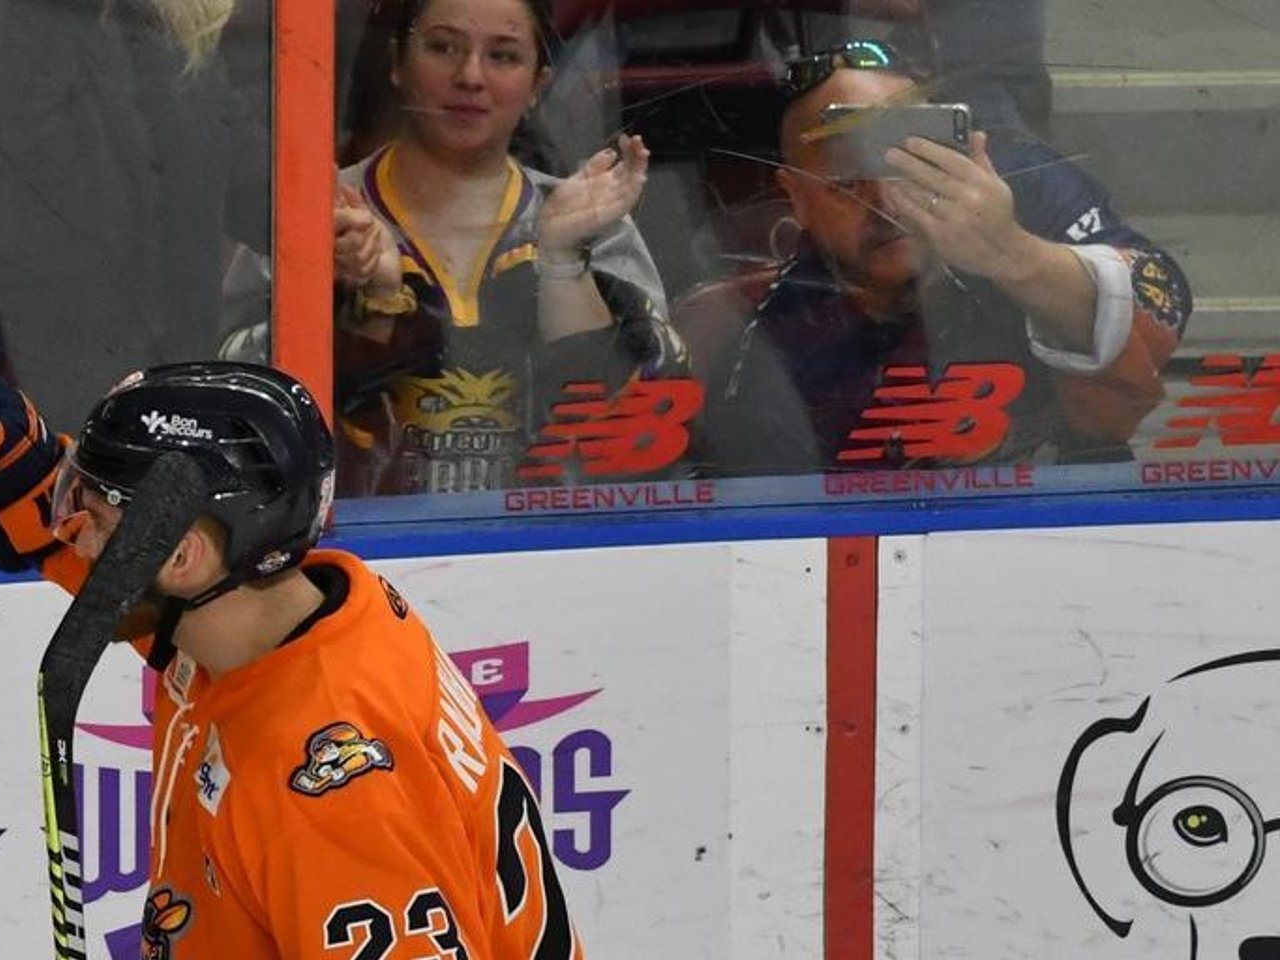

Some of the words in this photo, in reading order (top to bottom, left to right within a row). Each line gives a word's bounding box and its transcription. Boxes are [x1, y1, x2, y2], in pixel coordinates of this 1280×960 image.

[171, 414, 197, 431] Bon
[824, 462, 1035, 496] GREENVILLE
[1142, 457, 1280, 484] GREENV
[504, 481, 715, 513] GREENVILLE
